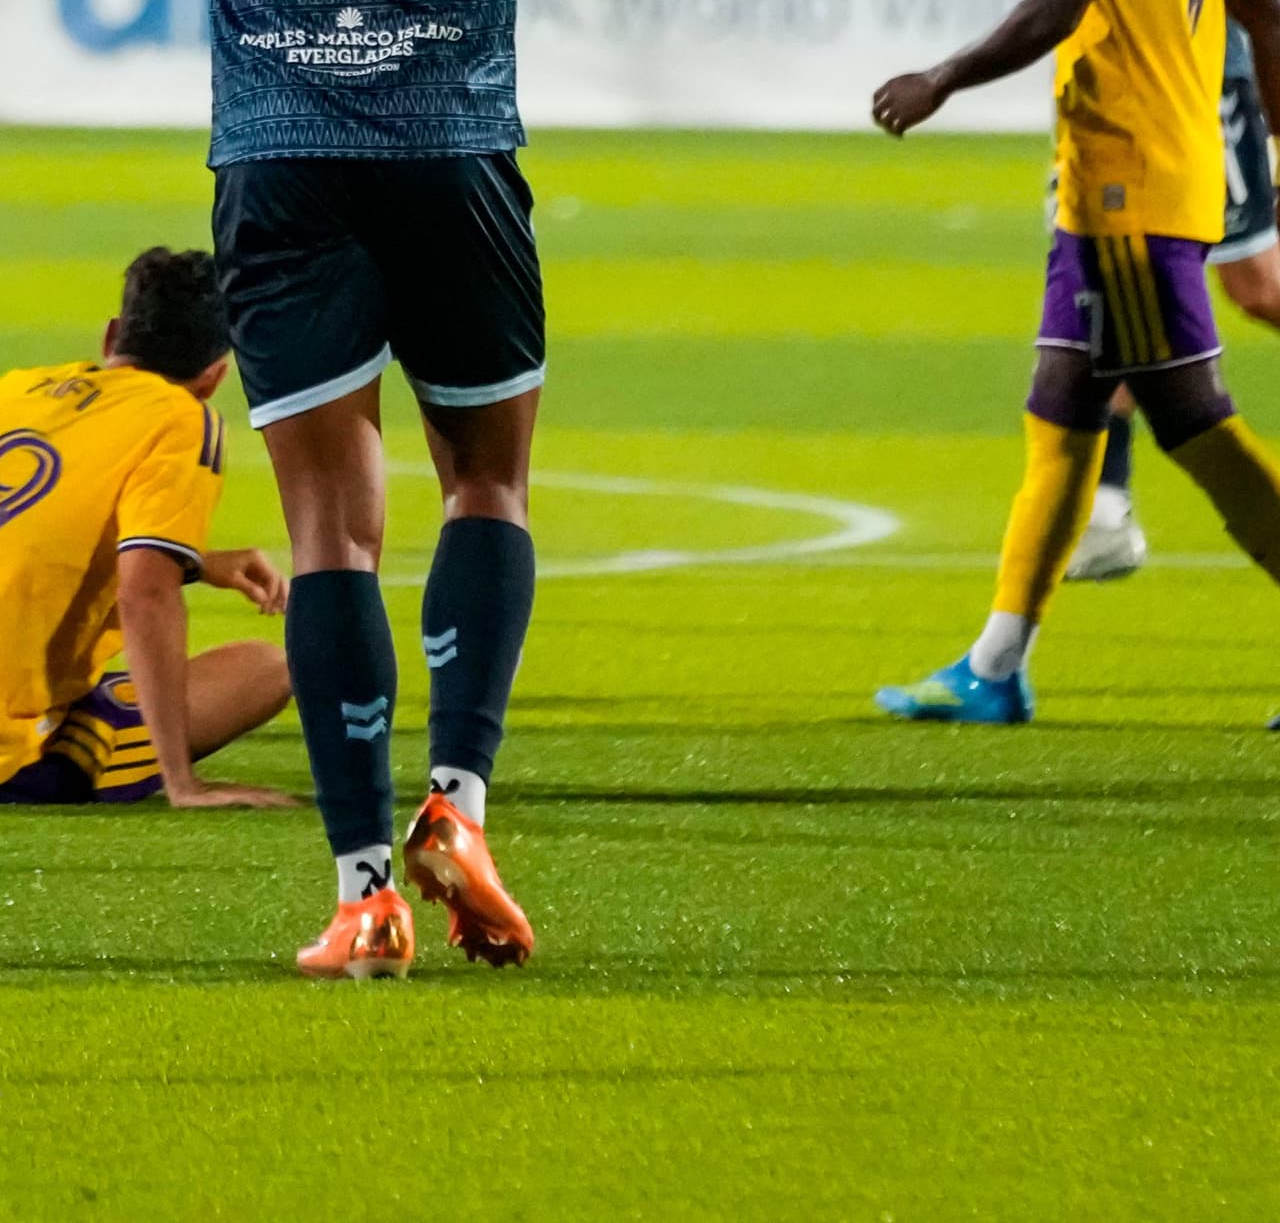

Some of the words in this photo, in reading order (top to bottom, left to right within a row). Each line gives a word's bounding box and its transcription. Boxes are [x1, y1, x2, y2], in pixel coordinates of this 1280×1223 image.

[239, 30, 306, 50] NAPLES
[318, 30, 393, 46] MARCO
[397, 24, 463, 42] ISLAND
[287, 41, 414, 64] EVERGLADES
